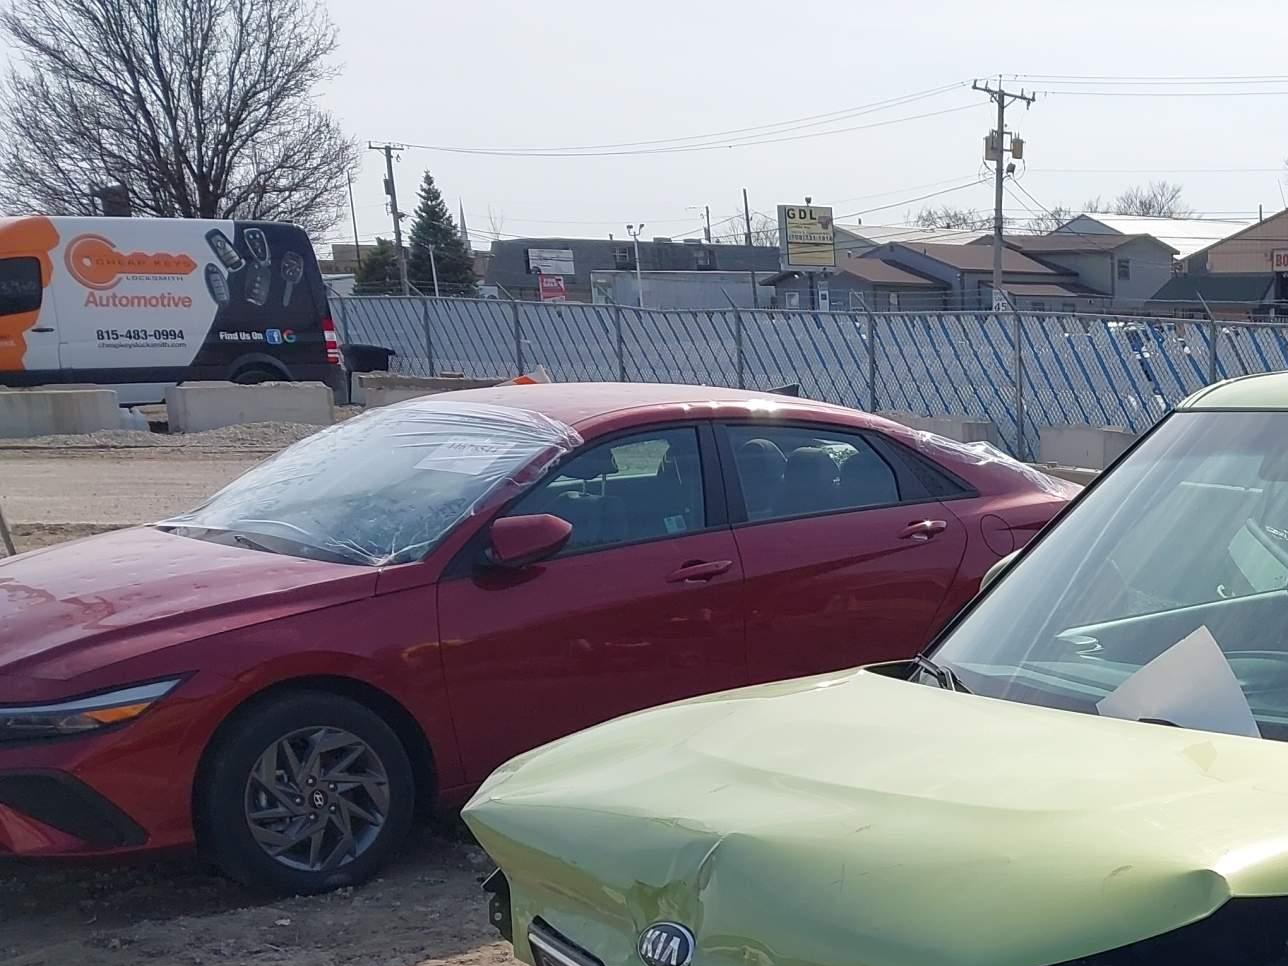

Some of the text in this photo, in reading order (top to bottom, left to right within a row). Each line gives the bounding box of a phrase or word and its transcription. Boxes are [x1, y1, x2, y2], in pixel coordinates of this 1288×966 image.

[84, 291, 193, 308] Automotive
[96, 329, 185, 341] 815-483-0994
[219, 331, 239, 340] Find
[240, 331, 251, 340] Us
[251, 331, 263, 340] On
[640, 928, 681, 966] KIA
